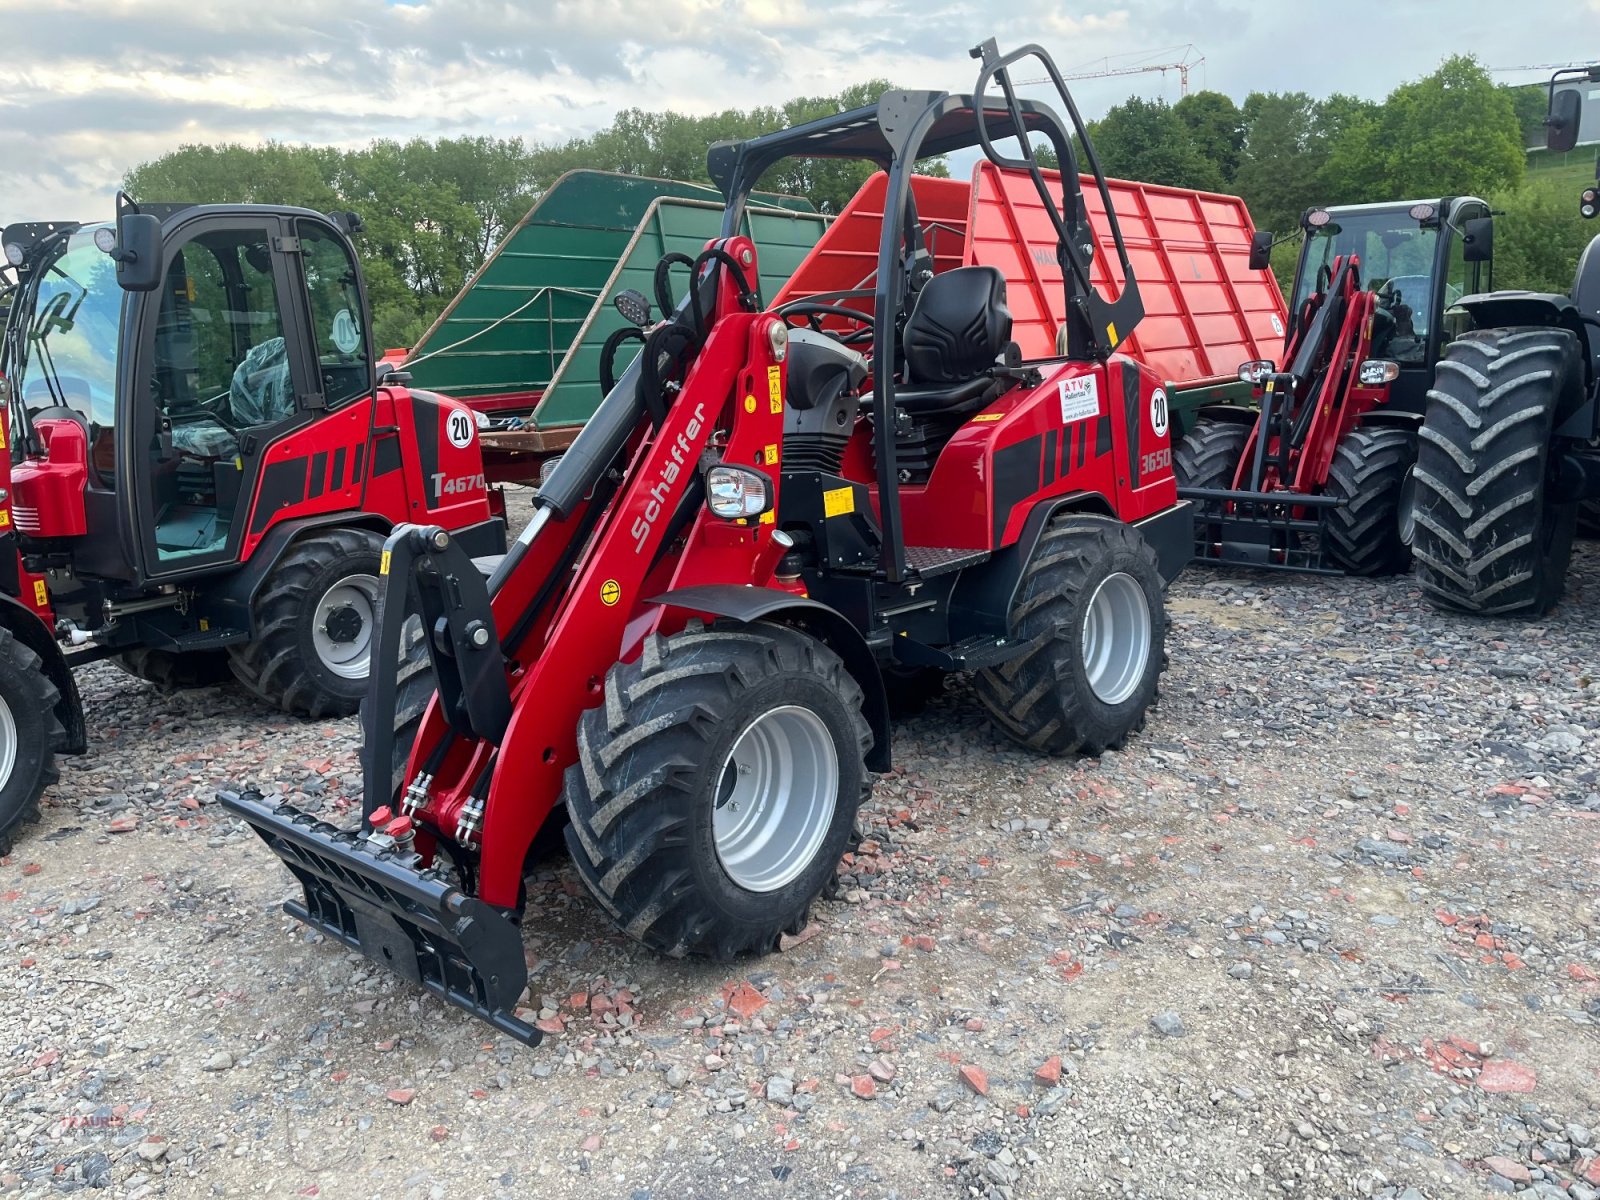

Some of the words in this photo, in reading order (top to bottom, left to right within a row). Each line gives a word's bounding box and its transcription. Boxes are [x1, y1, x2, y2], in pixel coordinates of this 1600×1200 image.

[1154, 397, 1166, 428] 20
[452, 416, 469, 441] 20
[1141, 447, 1172, 476] 3650
[431, 472, 486, 498] T4670
[631, 402, 705, 554] Schäffer
